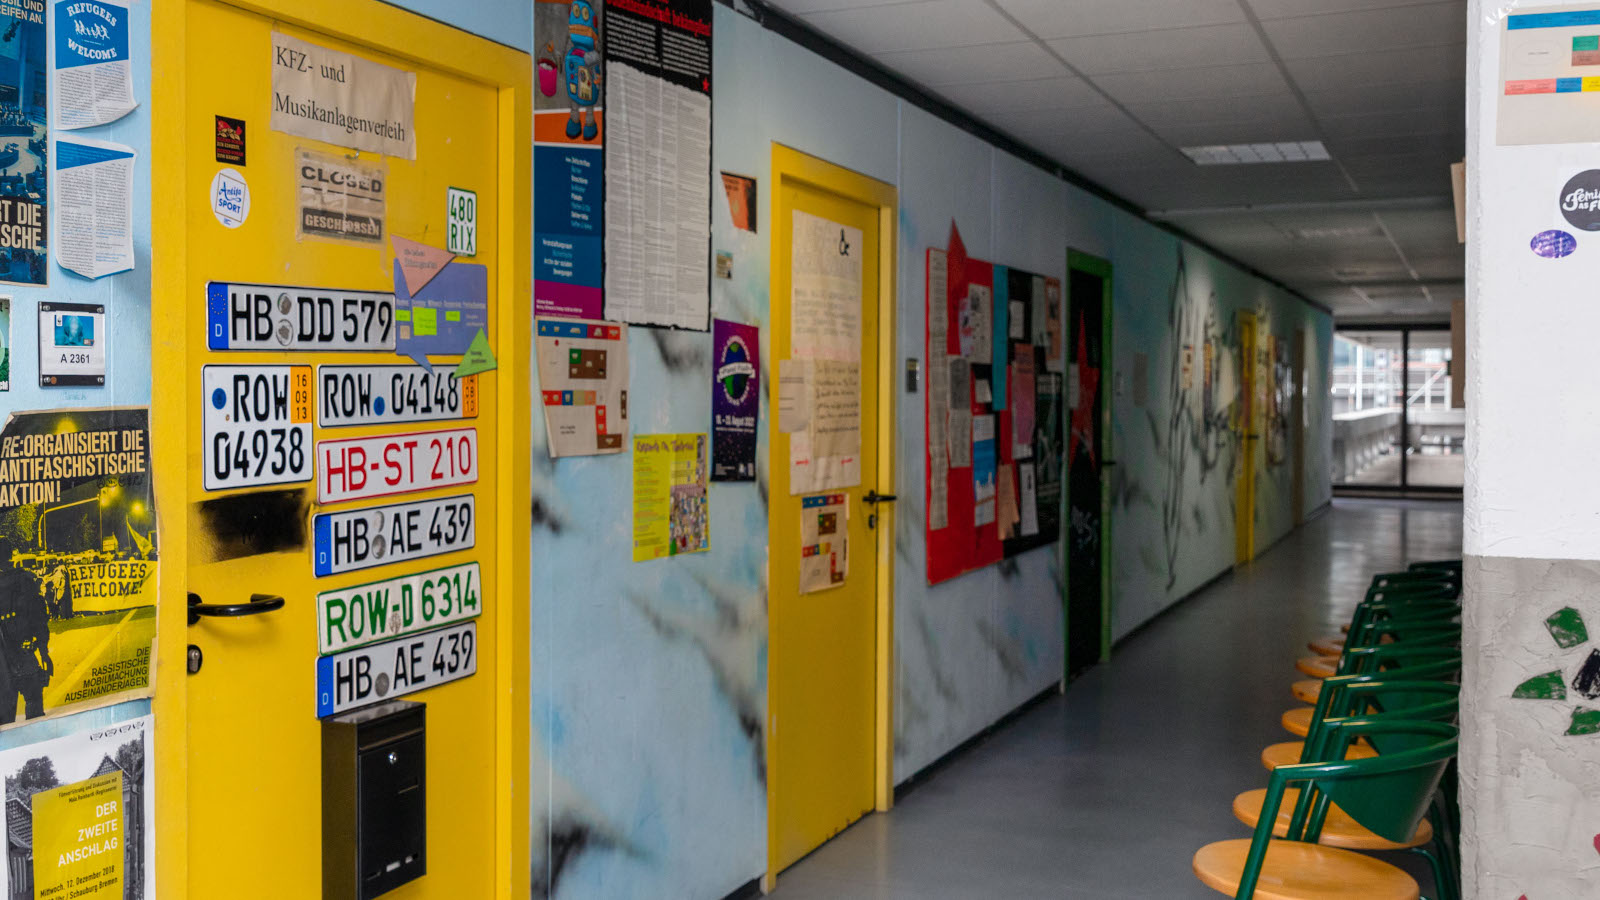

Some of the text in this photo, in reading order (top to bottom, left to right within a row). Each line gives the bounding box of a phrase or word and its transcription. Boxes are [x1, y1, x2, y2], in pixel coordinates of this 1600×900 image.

[0, 4, 43, 24] EIFEN AN.
[24, 0, 43, 12] UND
[66, 2, 117, 27] REFUGEES
[67, 37, 117, 60] WELCOME
[276, 46, 345, 83] KFZ- und
[275, 92, 405, 141] Musikanlagenverleih
[219, 181, 242, 202] Antifa
[301, 166, 382, 193] CLOSED
[17, 203, 42, 227] DIE
[218, 198, 241, 214] SPORT
[450, 194, 473, 223] 480
[450, 223, 473, 252] RIX
[231, 293, 392, 343] HB DD 579
[60, 354, 90, 364] A 2361
[296, 374, 308, 388] 16
[233, 374, 289, 423] ROW
[295, 393, 308, 404] 09
[323, 372, 459, 419] ROW 04148
[296, 406, 308, 420] 13
[1, 430, 144, 458] RE:ORGANISIERT DIE
[213, 427, 304, 481] 04938
[0, 451, 146, 484] ANTIFASCHISTISCHE
[325, 435, 472, 495] HB-ST 210
[0, 480, 61, 508] AKTION!
[334, 502, 472, 565] HB AE 439
[70, 563, 147, 582] REFUGEES
[72, 580, 144, 599] WELCOME!
[326, 570, 477, 646] ROW-D 6314
[136, 647, 150, 657] DIE
[83, 666, 148, 688] MOBILMACHUNG
[92, 656, 149, 677] RASSISTISCHE
[336, 630, 474, 705] HB AE 439
[65, 676, 147, 702] AUSEINANDERJAGEN
[96, 800, 117, 818] DER
[78, 818, 117, 842] ZWEITE
[58, 837, 118, 867] ANSCHLAG
[69, 884, 98, 899] Schauburg
[98, 876, 118, 890] Bremen
[75, 871, 101, 886] Dezember
[102, 865, 115, 876] 2018
